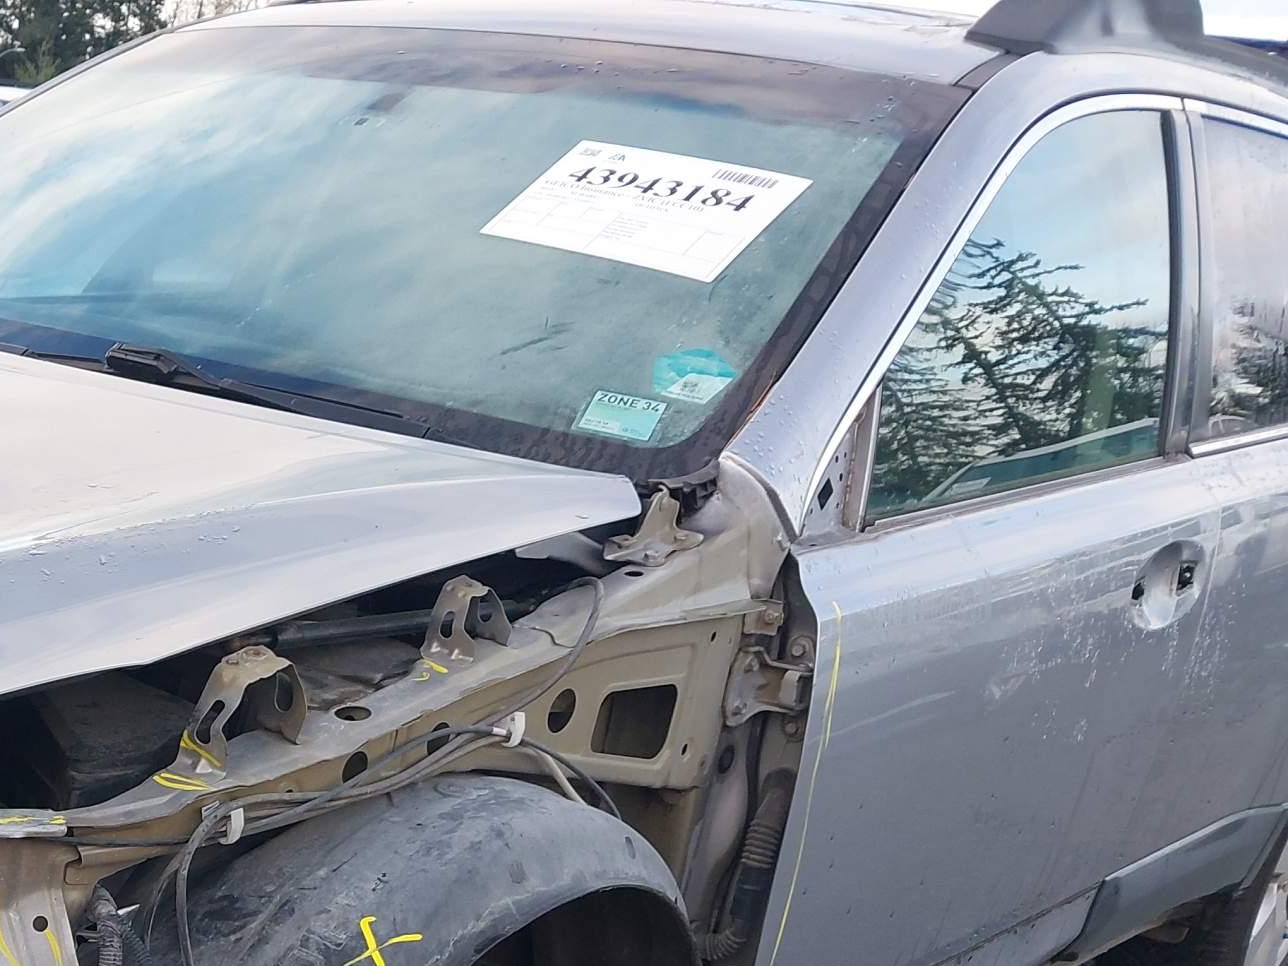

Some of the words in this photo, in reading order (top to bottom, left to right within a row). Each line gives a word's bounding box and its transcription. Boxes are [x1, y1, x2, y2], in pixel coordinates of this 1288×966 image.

[568, 165, 756, 213] 43943184
[597, 392, 641, 409] ZONE
[642, 401, 661, 413] 34
